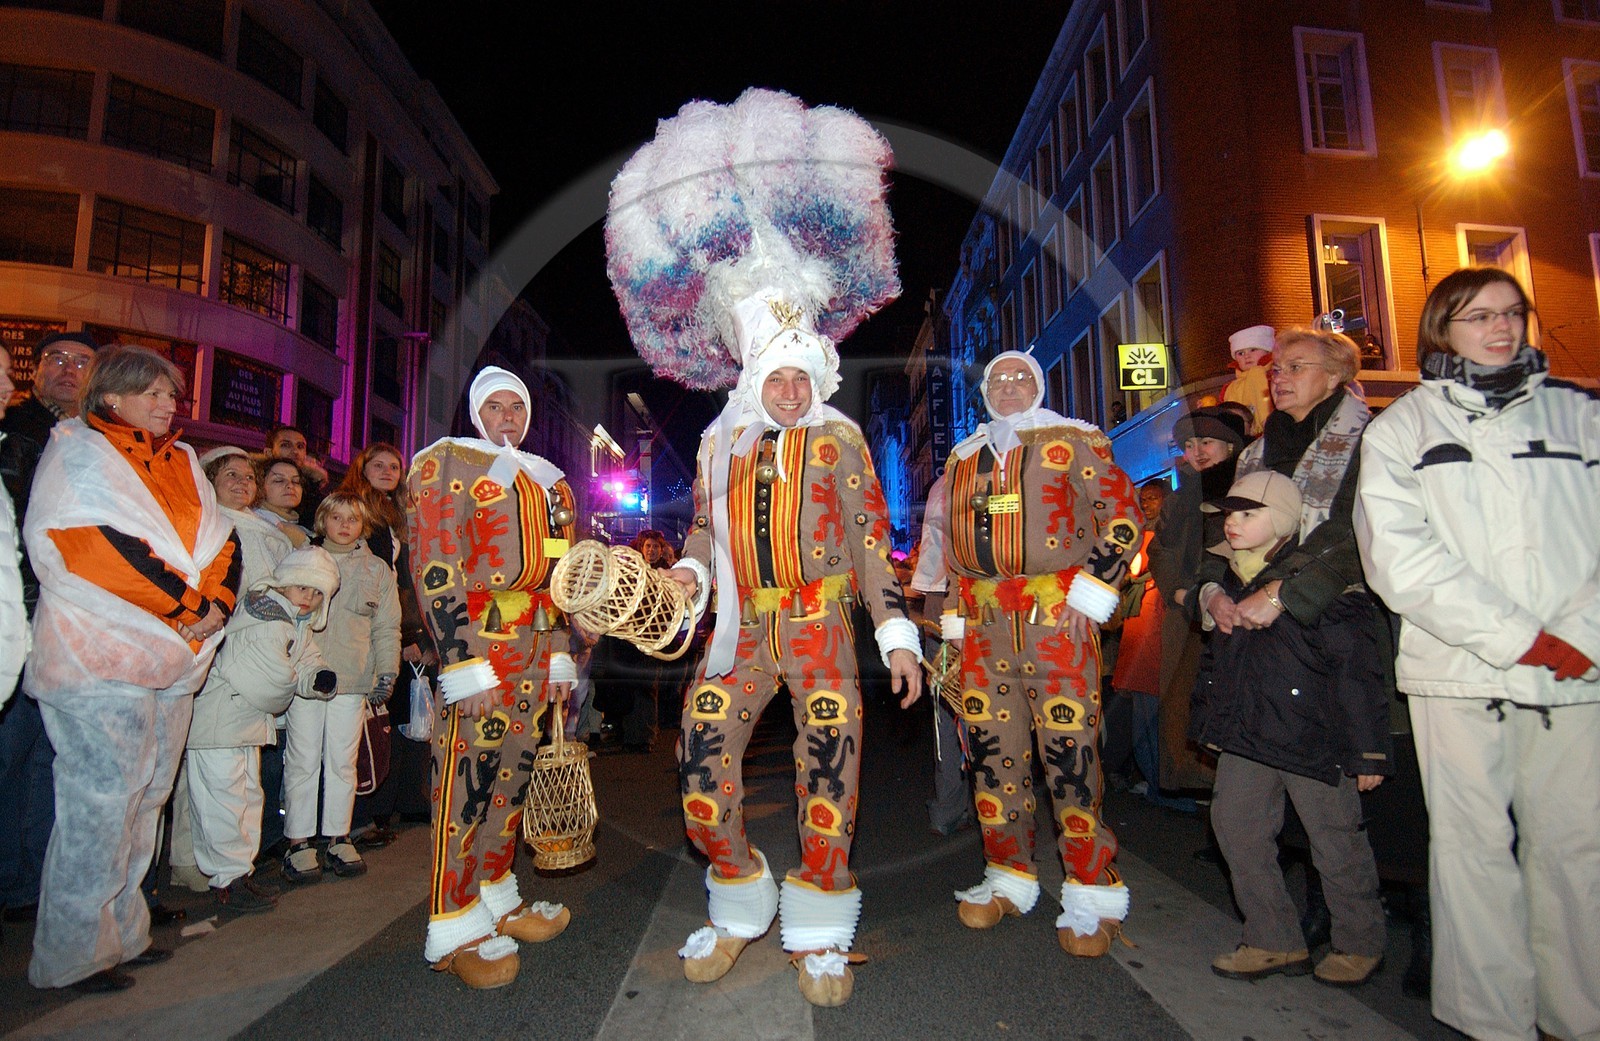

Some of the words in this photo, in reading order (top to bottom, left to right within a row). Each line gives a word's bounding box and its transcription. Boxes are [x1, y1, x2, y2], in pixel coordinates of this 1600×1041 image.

[2, 330, 25, 340] DES
[1131, 368, 1158, 385] CL
[228, 391, 240, 400] AU
[931, 366, 946, 477] AFFLELO
